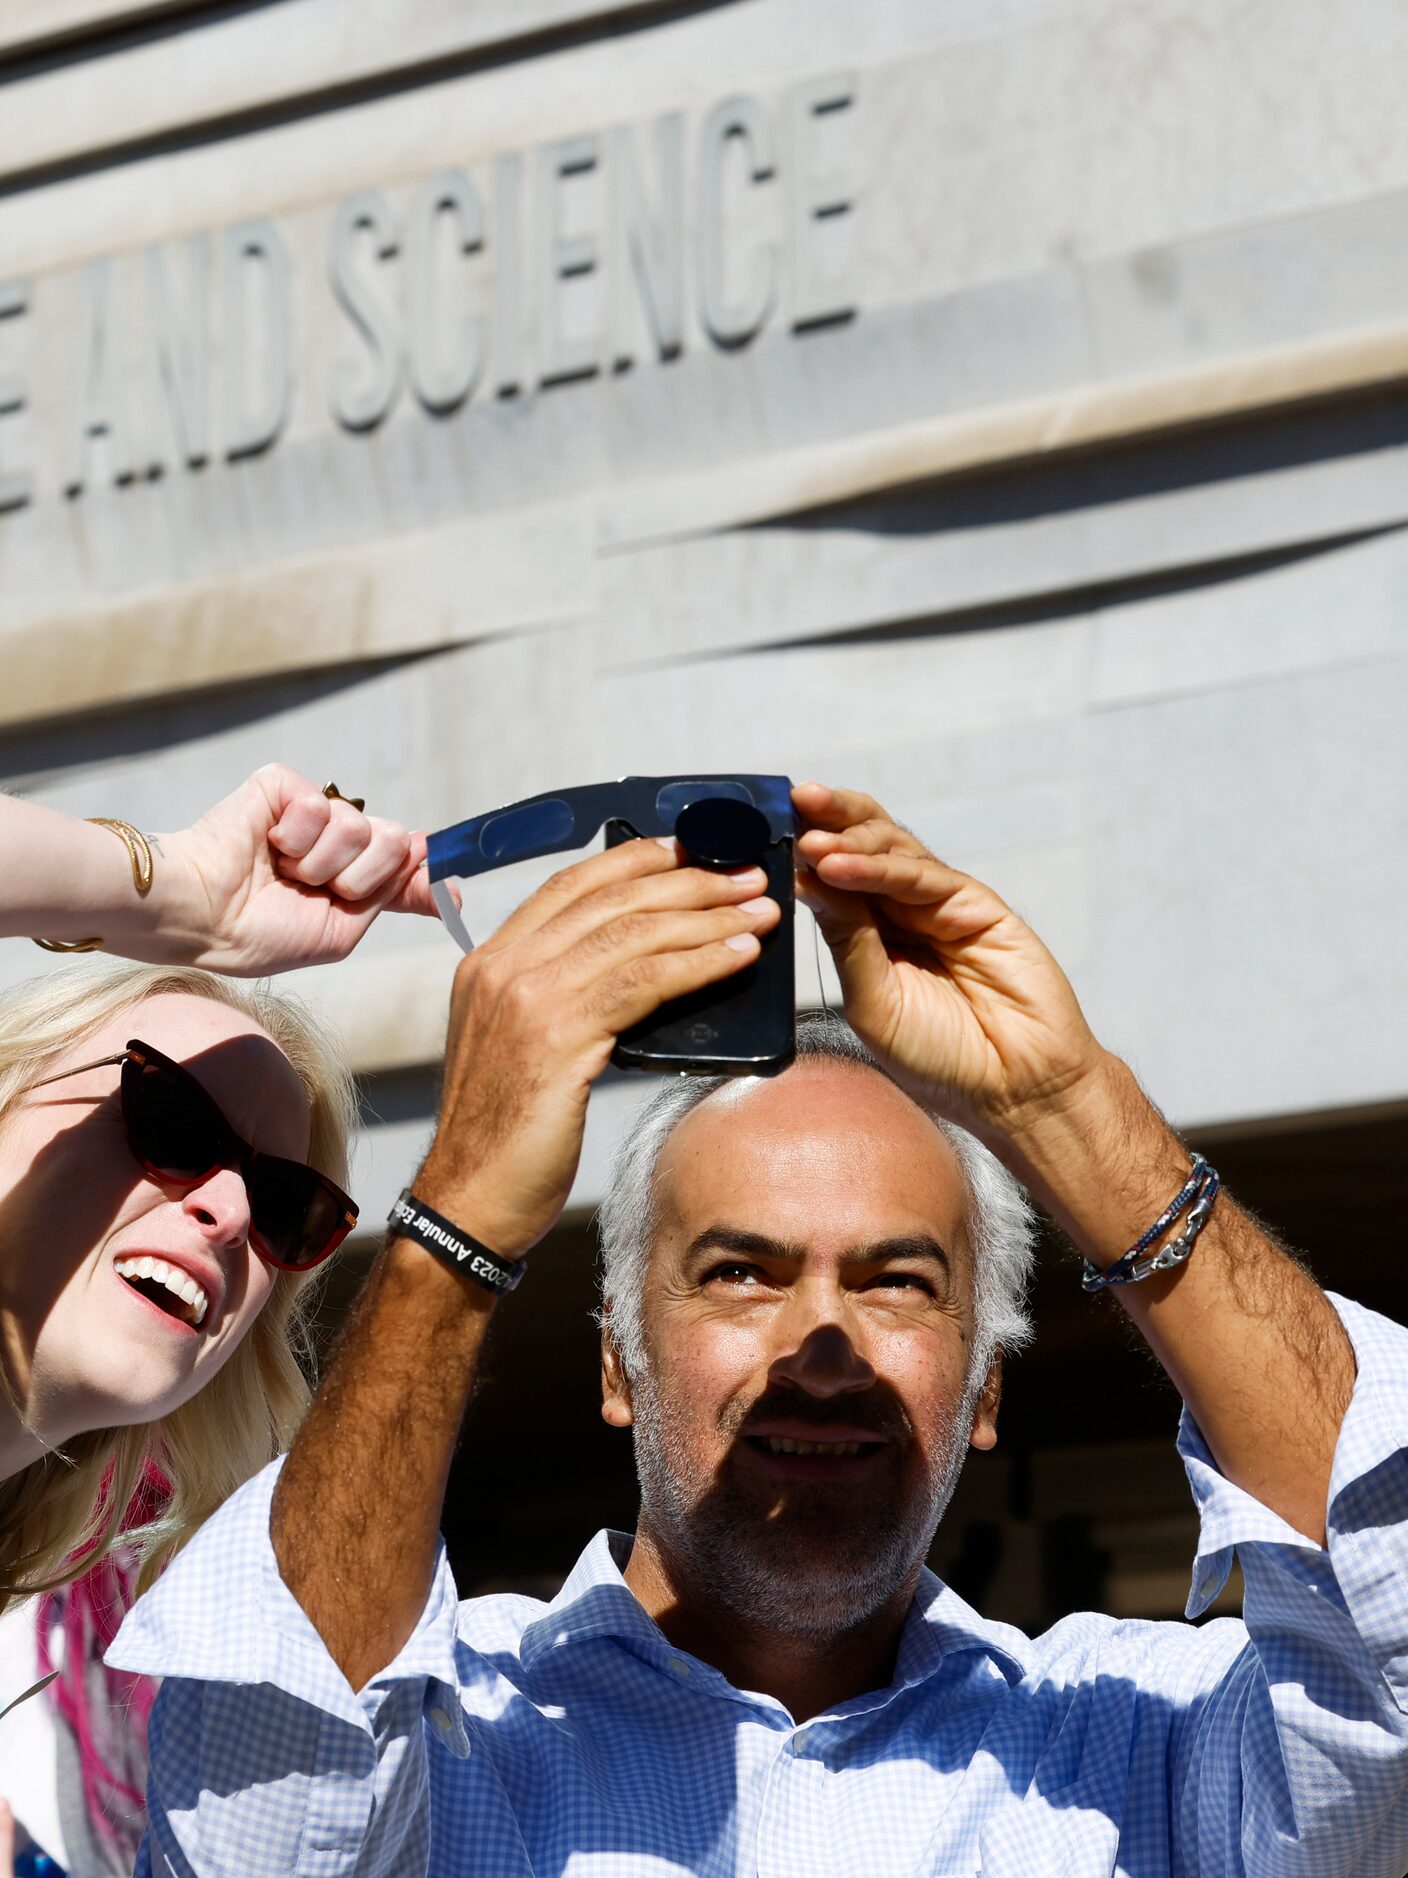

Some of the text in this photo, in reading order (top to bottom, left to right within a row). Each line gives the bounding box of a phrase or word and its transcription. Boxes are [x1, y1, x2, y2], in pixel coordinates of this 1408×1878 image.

[62, 213, 293, 504] AND
[330, 72, 860, 434] SCIENCE
[413, 1215, 472, 1262] Annular
[470, 1256, 511, 1286] 2023
